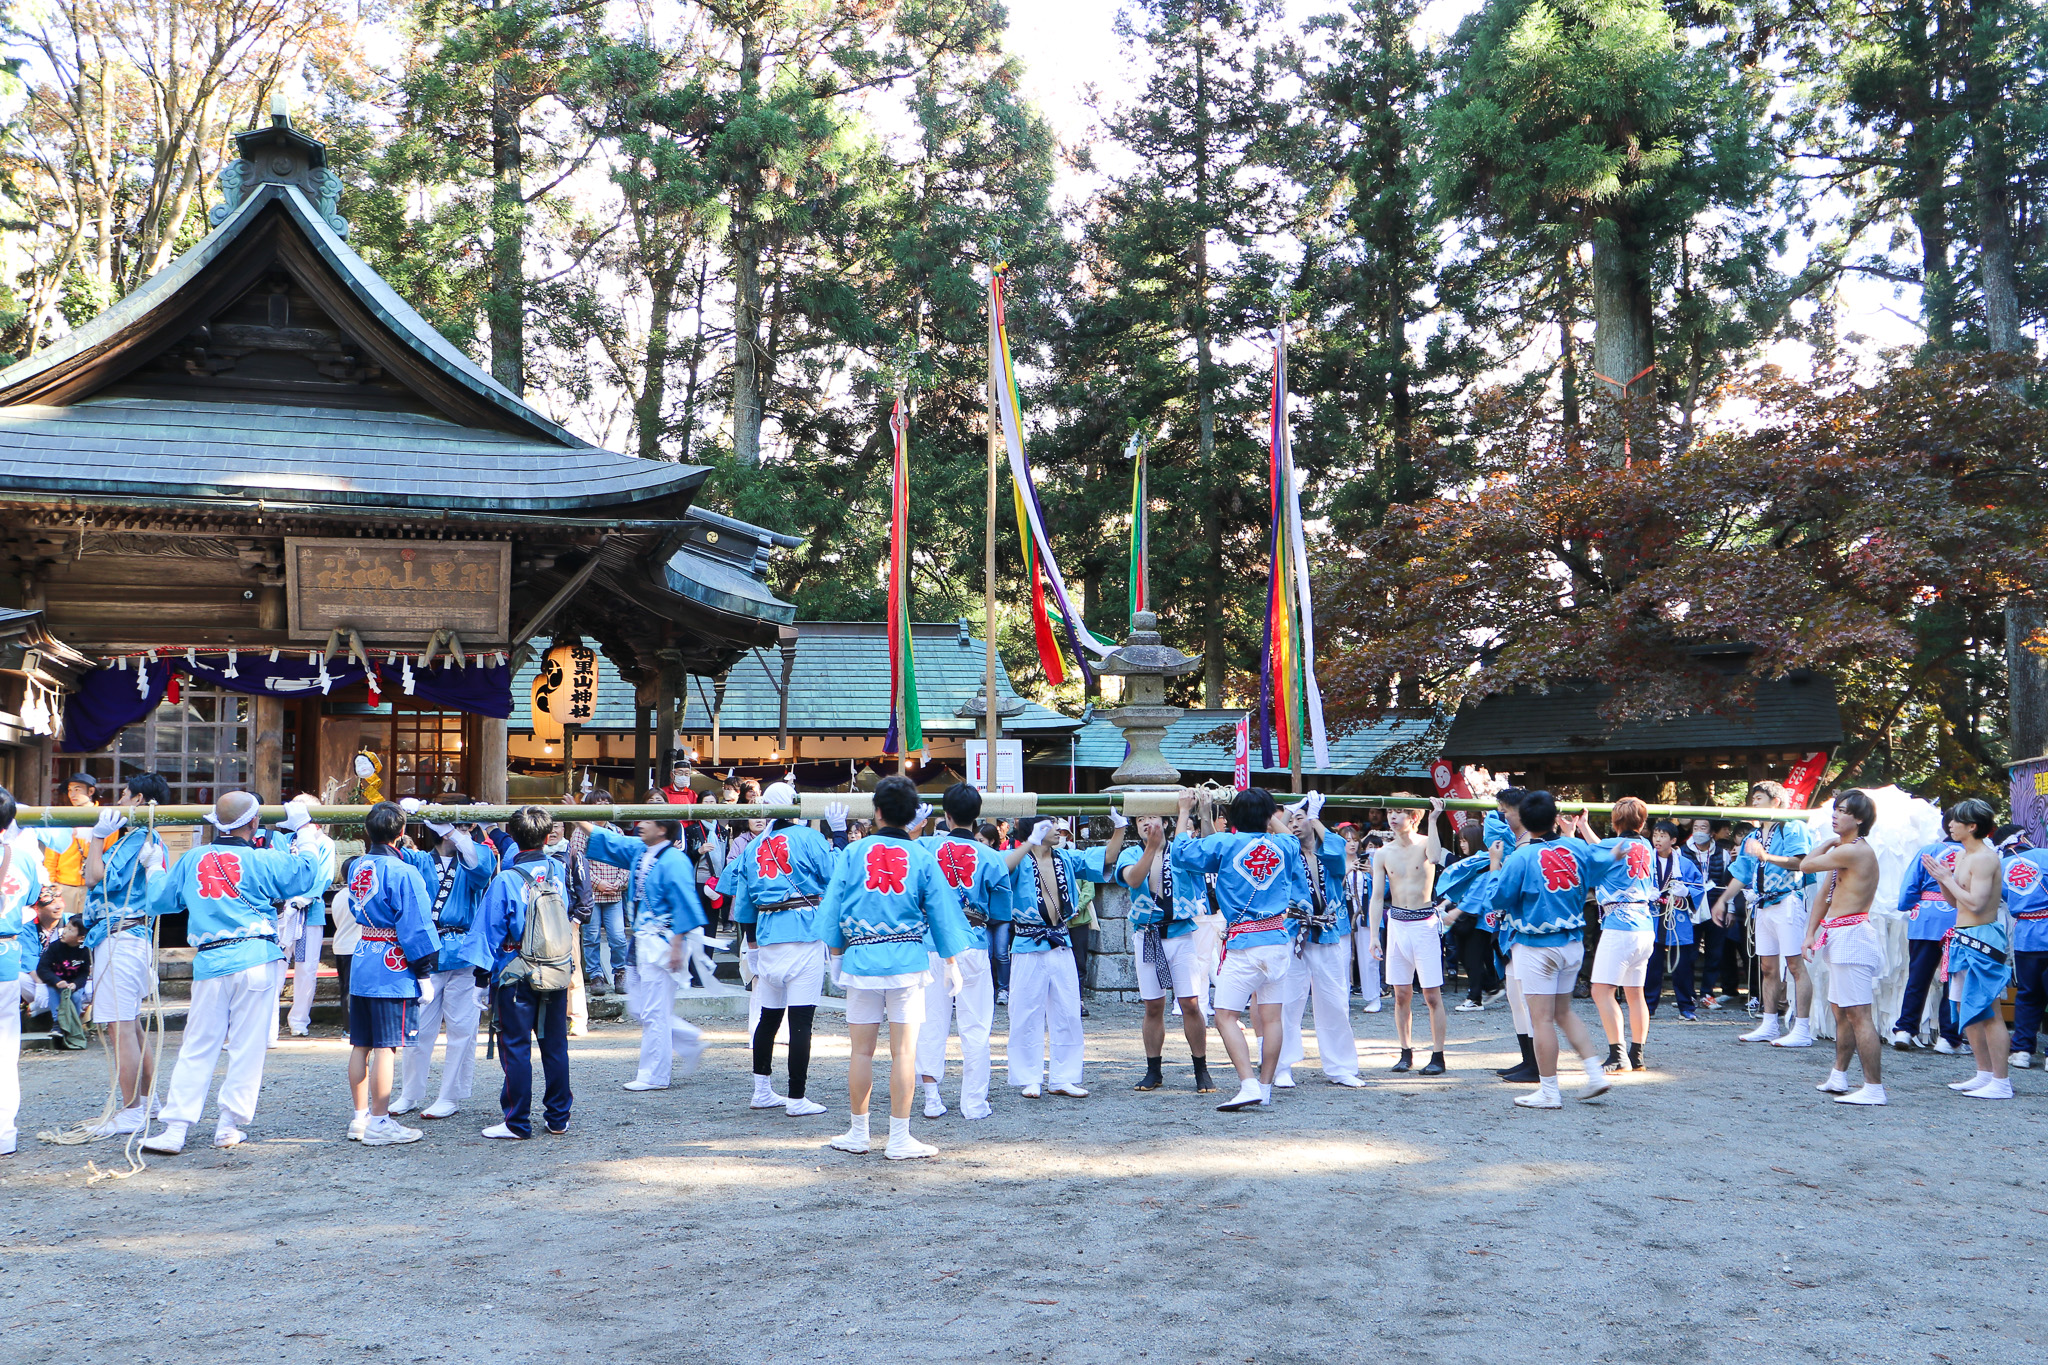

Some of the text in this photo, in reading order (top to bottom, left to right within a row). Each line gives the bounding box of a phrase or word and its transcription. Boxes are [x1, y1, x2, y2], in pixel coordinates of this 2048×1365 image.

[569, 648, 595, 719] 羽黒山神社
[866, 843, 909, 894] 祭
[1244, 844, 1281, 881] 祭
[2008, 862, 2037, 889] 祭
